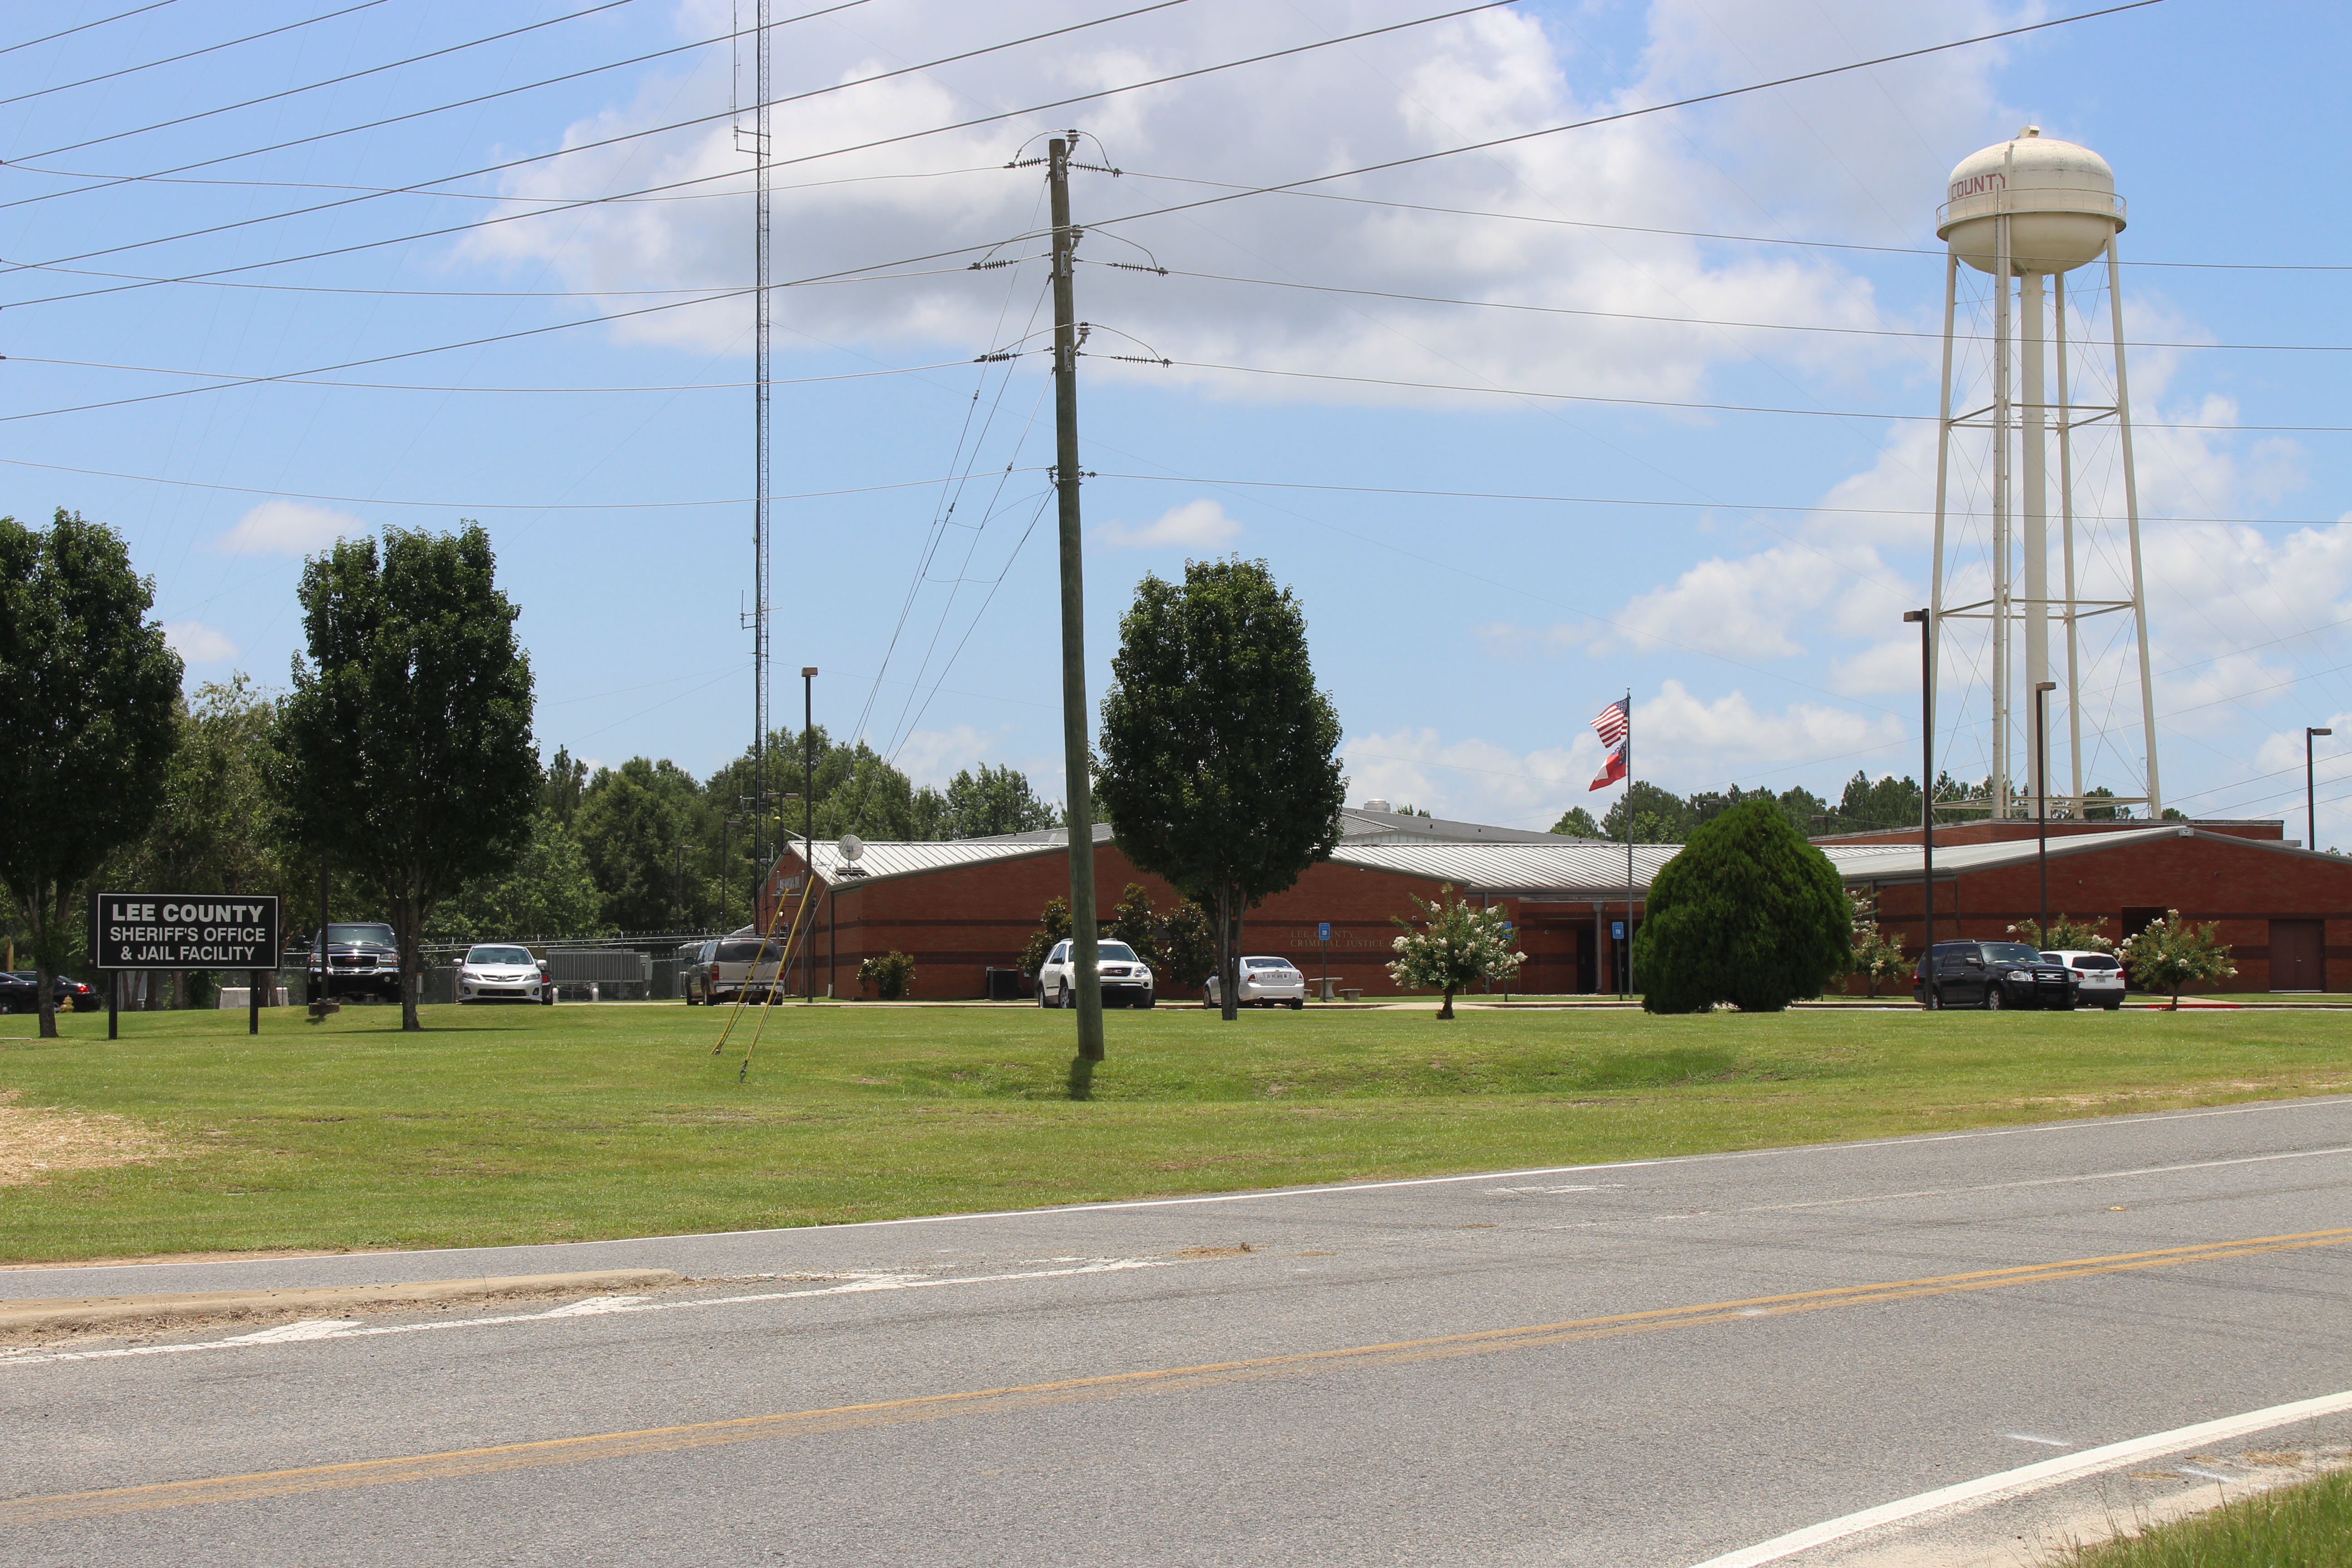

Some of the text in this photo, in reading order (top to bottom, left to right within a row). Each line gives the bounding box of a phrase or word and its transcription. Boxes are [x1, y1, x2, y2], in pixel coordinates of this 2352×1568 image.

[1951, 173, 2005, 200] COUNTY
[113, 904, 264, 922] LEE COUNTY
[110, 926, 265, 942] SHERIFF'S OFFICE
[121, 946, 255, 960] & JAIL FACILITY
